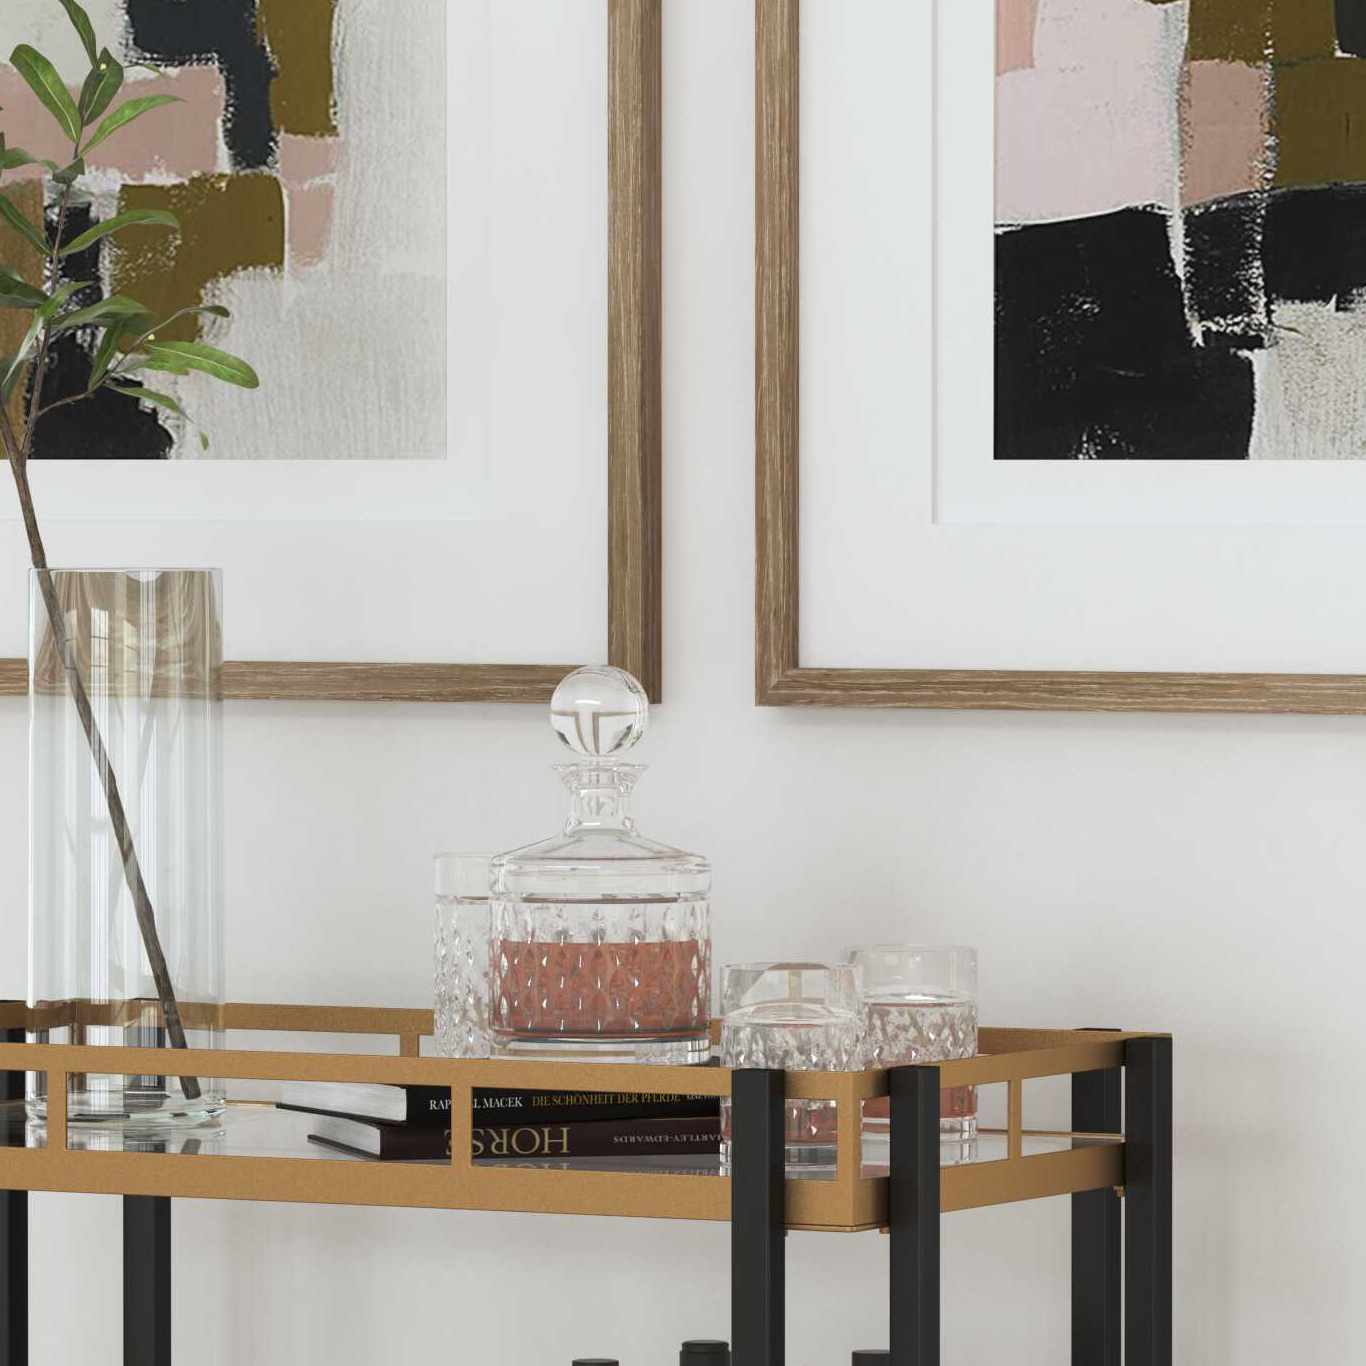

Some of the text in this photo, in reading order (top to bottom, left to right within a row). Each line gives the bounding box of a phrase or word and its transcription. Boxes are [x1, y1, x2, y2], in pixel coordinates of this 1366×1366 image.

[429, 1096, 524, 1110] RAPL MACEK
[532, 1095, 551, 1107] DIE
[617, 1093, 639, 1104] DER
[444, 1126, 571, 1156] HORS
